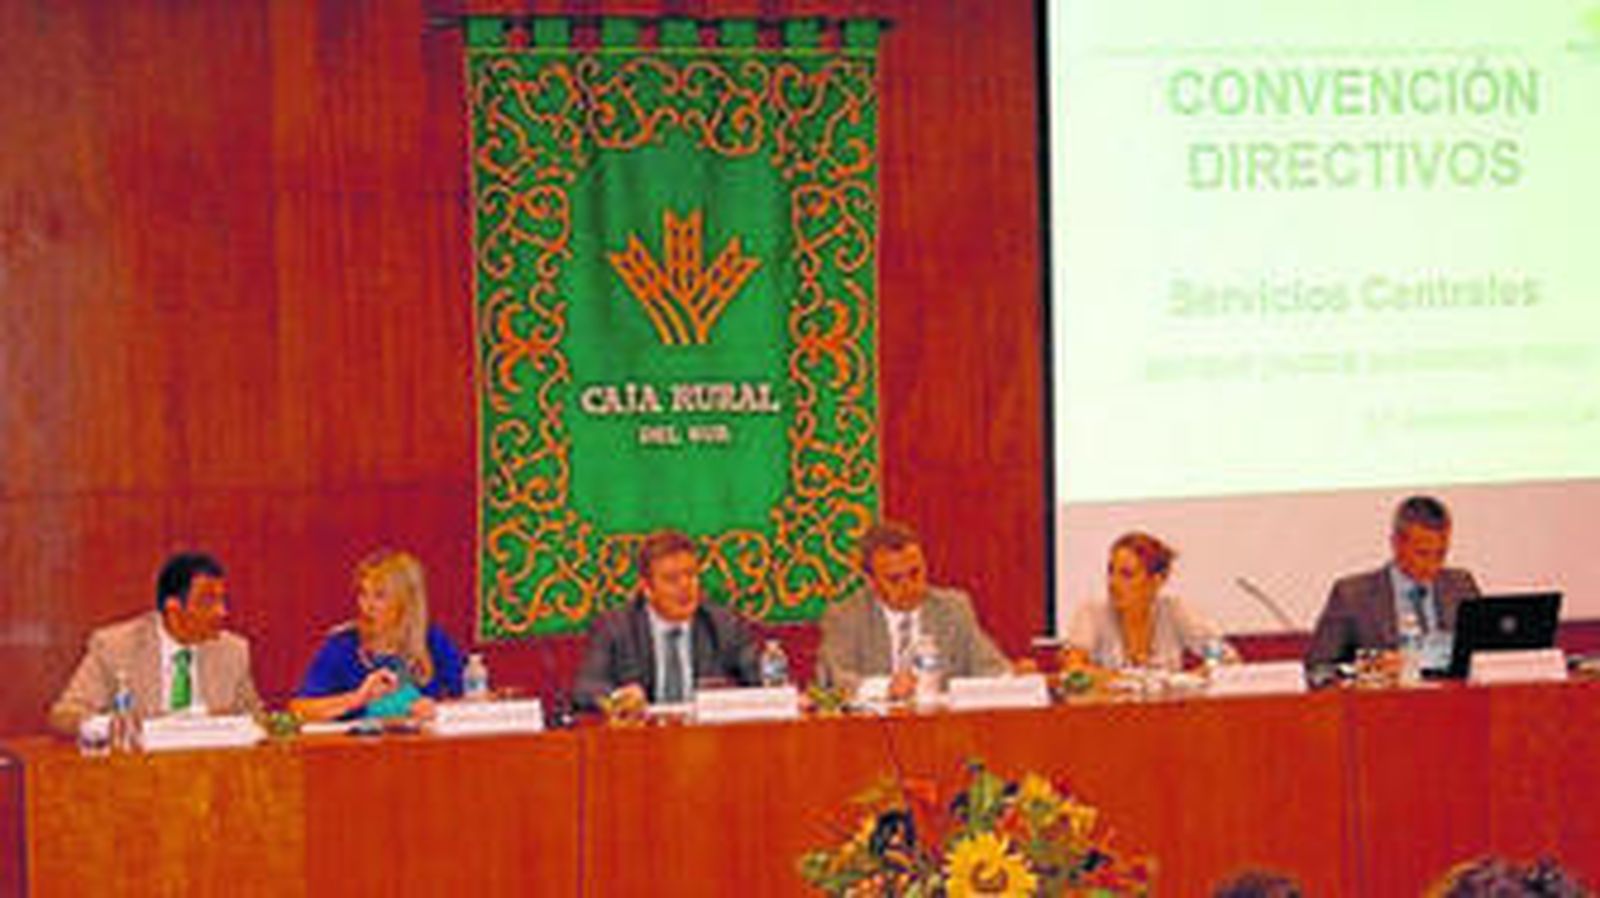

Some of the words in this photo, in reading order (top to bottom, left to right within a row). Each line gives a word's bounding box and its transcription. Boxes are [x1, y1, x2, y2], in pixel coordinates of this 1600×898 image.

[1168, 58, 1540, 117] CONVENCIÓN
[1187, 140, 1524, 190] DIRECTIVOS
[1167, 275, 1350, 317] Servicios
[1360, 271, 1541, 310] Centrales
[671, 382, 781, 413] RURAL
